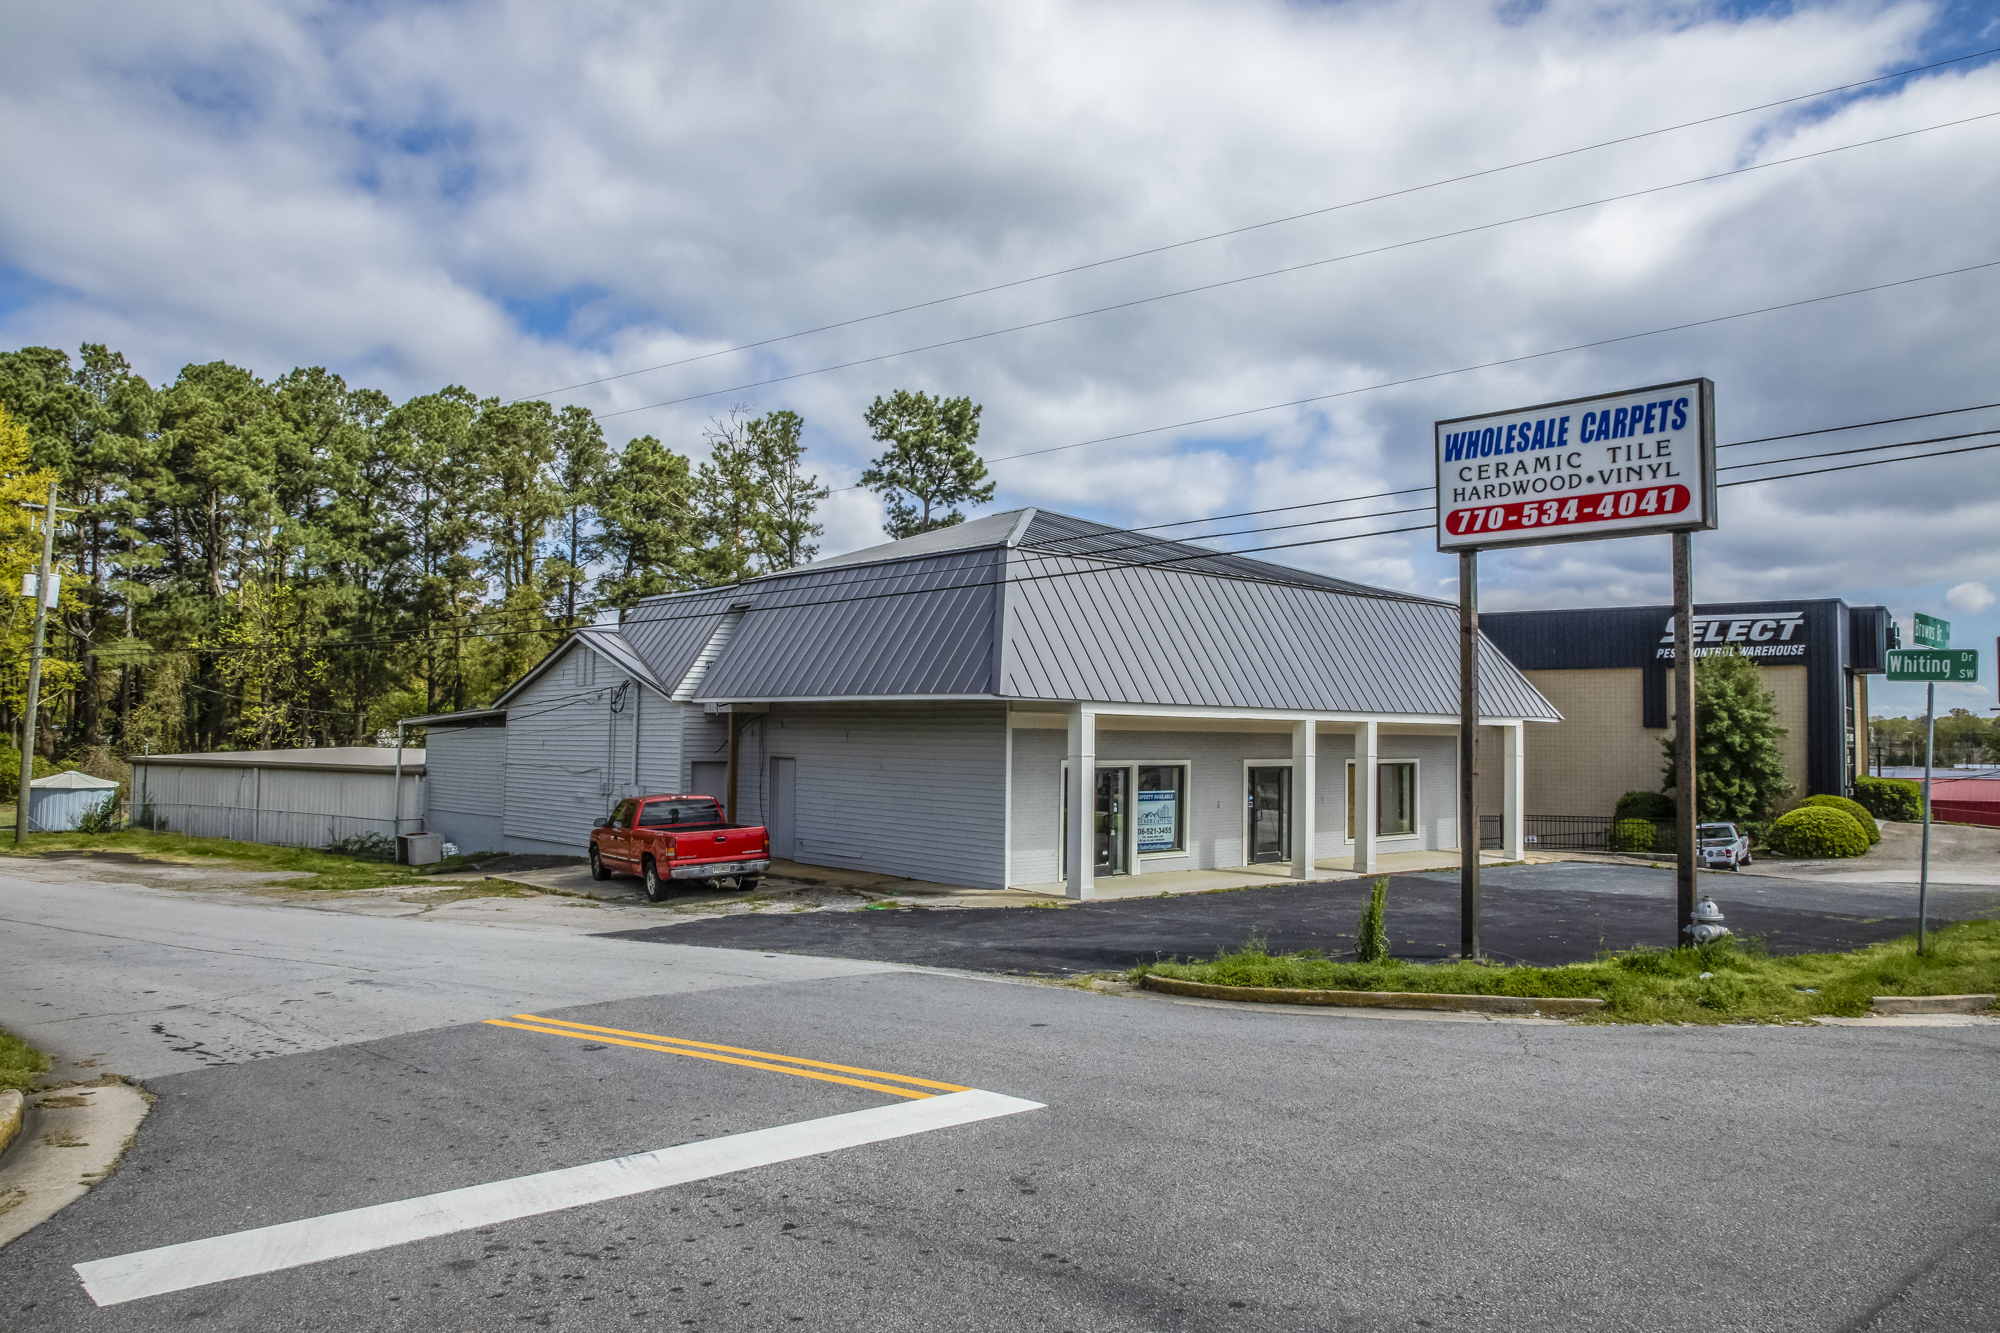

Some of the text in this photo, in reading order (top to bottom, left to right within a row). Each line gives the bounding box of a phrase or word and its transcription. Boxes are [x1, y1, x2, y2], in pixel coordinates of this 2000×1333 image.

[1445, 397, 1689, 462] WHOLESALE CARPETS
[1459, 439, 1672, 482] CERAMIC TILE
[1453, 461, 1680, 503] HARDWOOD VINYL
[1457, 488, 1676, 533] 770-534-4041
[1656, 645, 1806, 659] PES ONTROL WAREHOUSE
[1961, 652, 1974, 662] Dr
[1890, 655, 1951, 679] Whiting
[1959, 669, 1975, 679] SW
[1138, 827, 1172, 835] 06-521-3455
